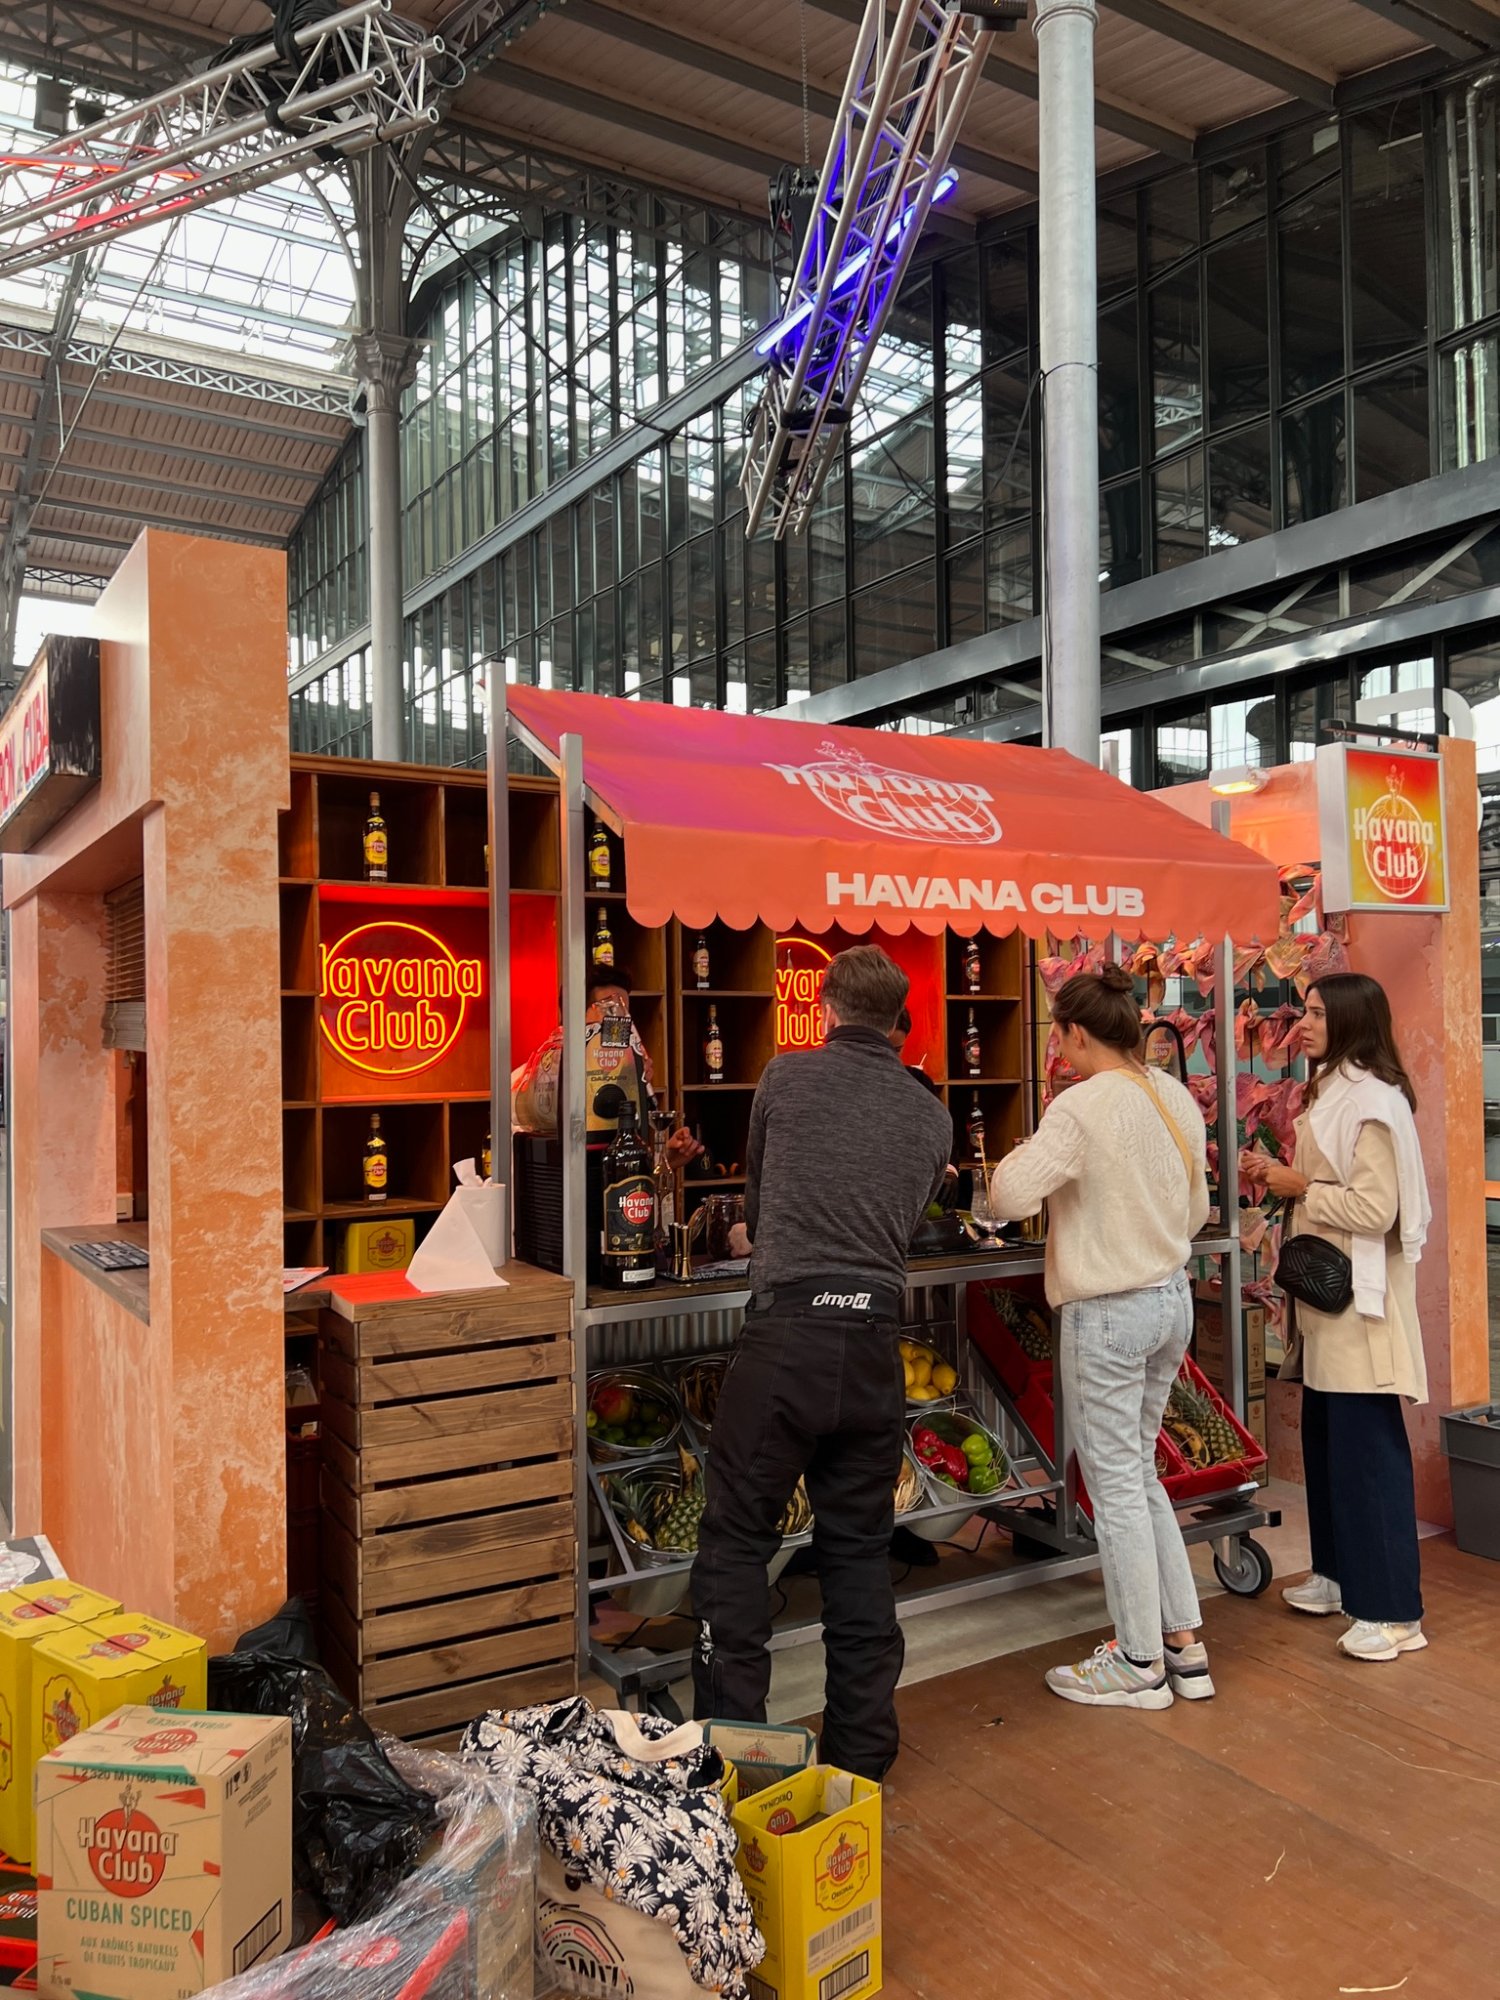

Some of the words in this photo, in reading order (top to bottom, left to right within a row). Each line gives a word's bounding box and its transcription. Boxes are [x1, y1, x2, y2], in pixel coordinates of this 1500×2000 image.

[761, 763, 994, 802] Havana
[848, 796, 983, 834] Club
[1353, 807, 1434, 845] Havana
[1373, 846, 1418, 878] Club
[826, 872, 1027, 912] HAVANA
[1030, 882, 1145, 917] CLUB
[336, 999, 446, 1050] Club
[776, 1003, 825, 1046] lub
[593, 1049, 624, 1058] Havana
[600, 1058, 617, 1067] Club
[619, 1196, 653, 1208] Havana
[627, 1208, 649, 1219] Club
[77, 1817, 176, 1856] Havana
[771, 1812, 790, 1830] Club
[98, 1851, 153, 1883] Club
[833, 1859, 850, 1878] Club
[66, 1897, 123, 1925] CUBAN
[130, 1904, 192, 1932] SPICED
[80, 1936, 97, 1948] AUX
[100, 1936, 134, 1953] ARÔMES
[137, 1943, 179, 1958] NATURELS
[84, 1951, 94, 1963] DE
[97, 1953, 126, 1968] FRUITS
[129, 1956, 176, 1972] TROPICAUX
